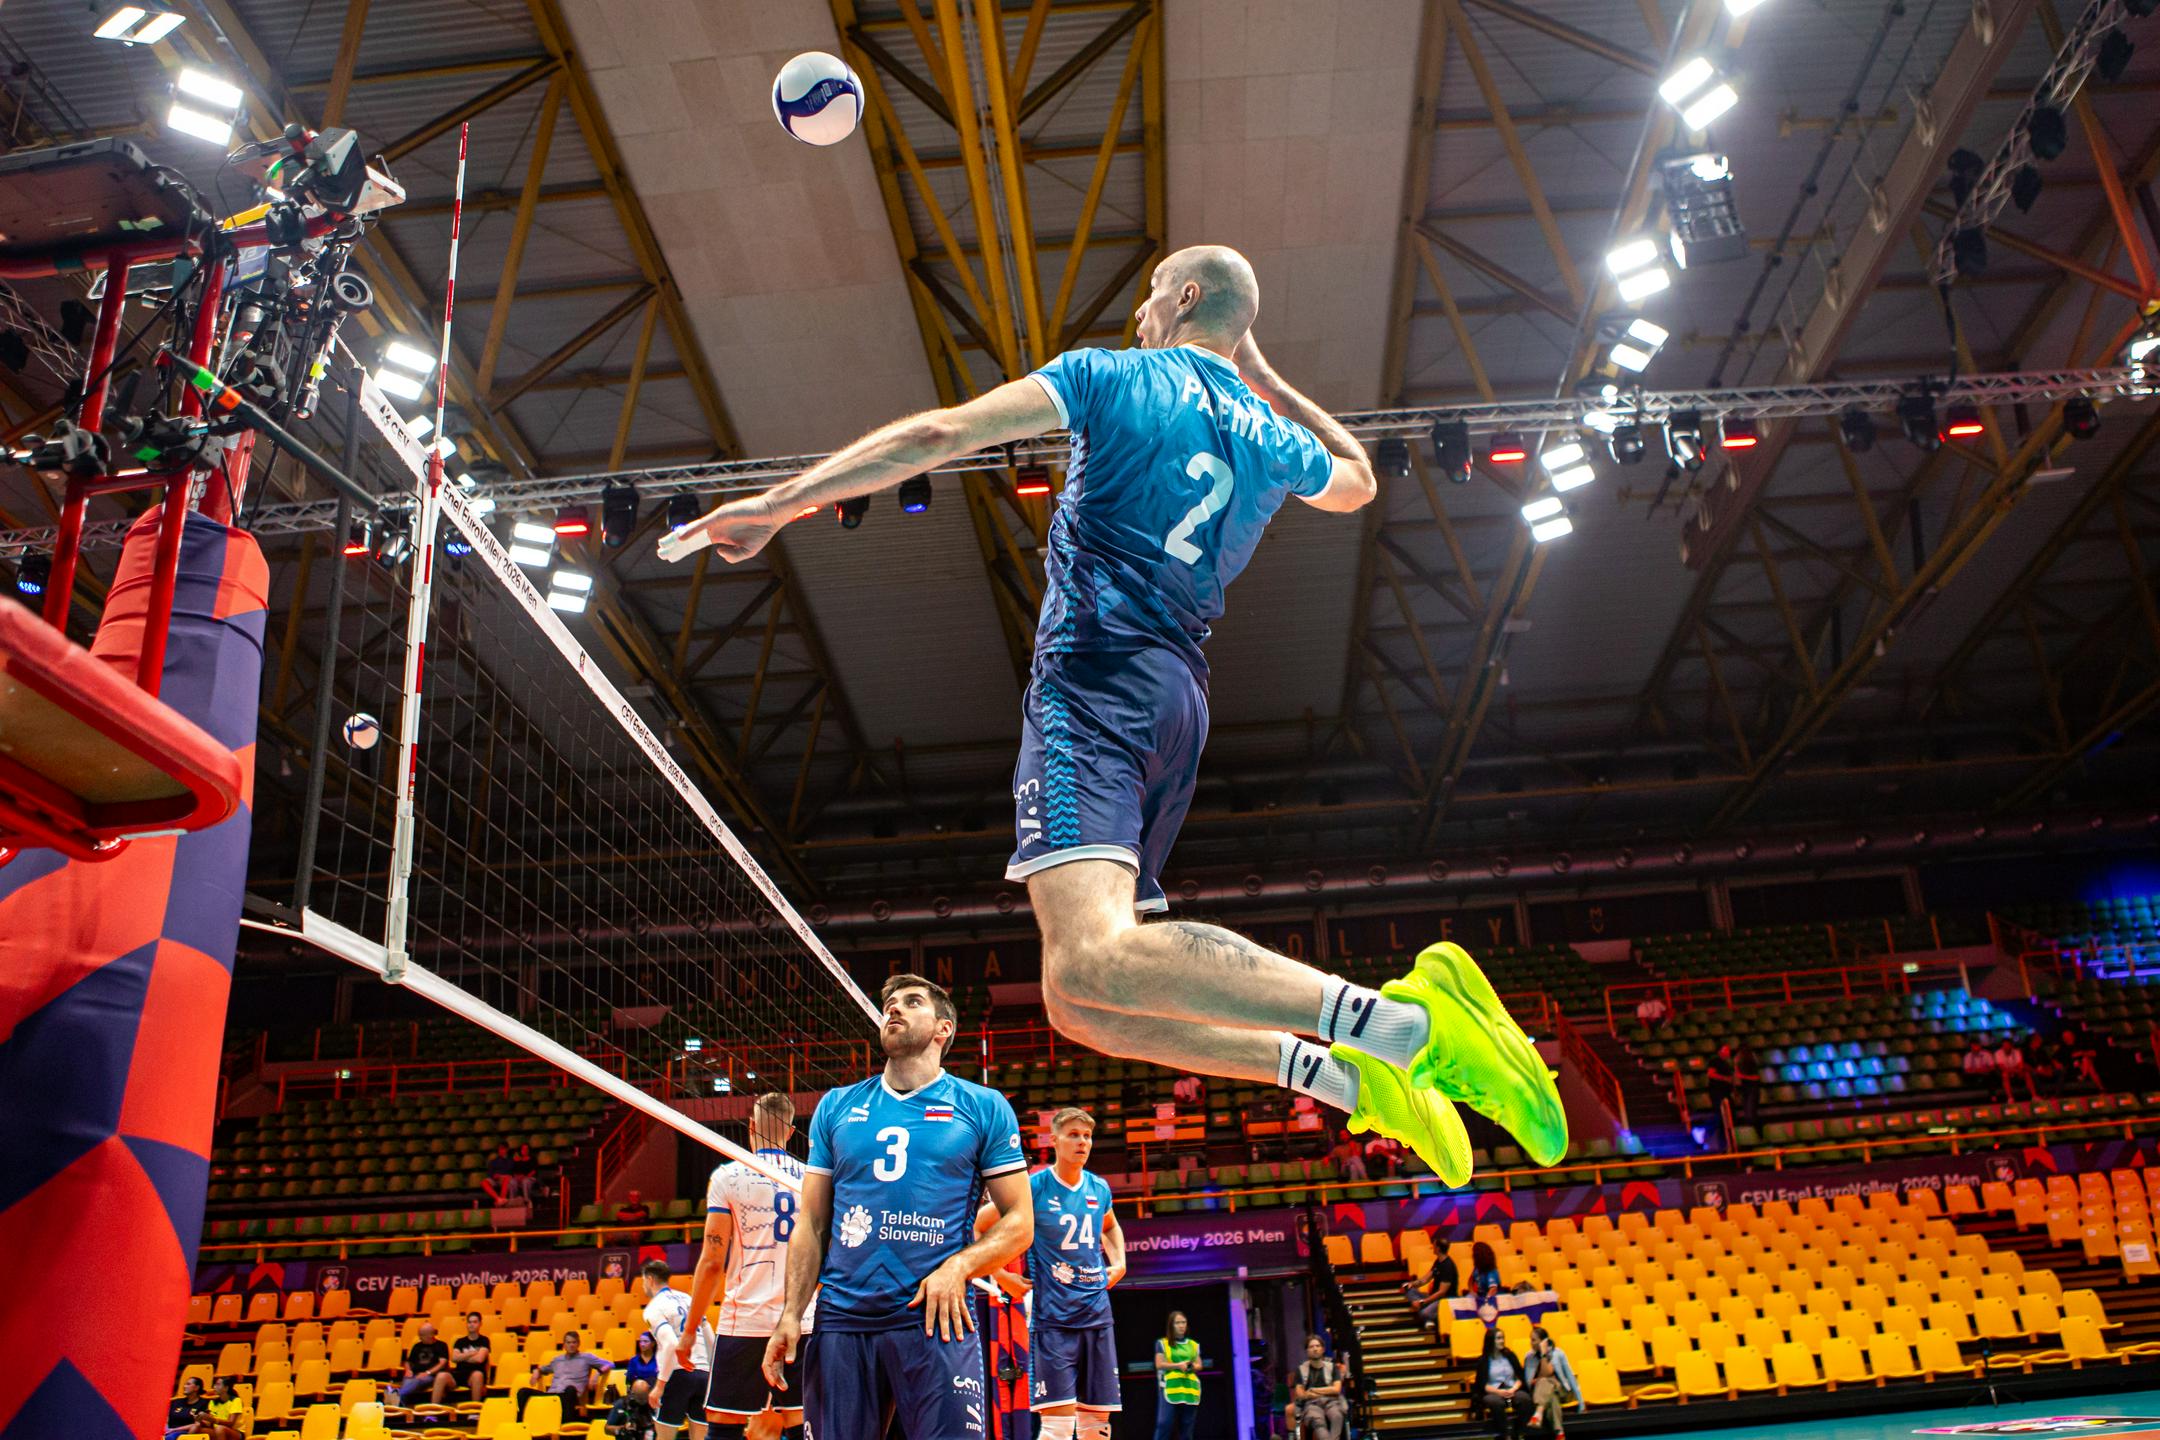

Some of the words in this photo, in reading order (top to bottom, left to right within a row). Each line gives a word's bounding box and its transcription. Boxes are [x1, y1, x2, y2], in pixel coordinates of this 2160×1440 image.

[1164, 452, 1234, 565] 2
[443, 483, 463, 516] Enel
[461, 505, 502, 568] EuroVolley
[502, 557, 522, 588] 2026
[521, 583, 538, 610] Men
[873, 1126, 910, 1182] 3
[773, 1191, 796, 1243] 8
[881, 1210, 946, 1230] Telekom
[1059, 1213, 1095, 1250] 24
[878, 1226, 945, 1247] Slovenije
[1125, 1232, 1200, 1252] uroVolley
[1203, 1230, 1244, 1247] 2026
[1247, 1229, 1285, 1244] Men
[356, 1276, 389, 1292] CEV
[391, 1274, 424, 1289] Enel
[511, 1269, 550, 1285] 2026
[553, 1267, 588, 1282] Men
[1034, 1380, 1048, 1398] 24
